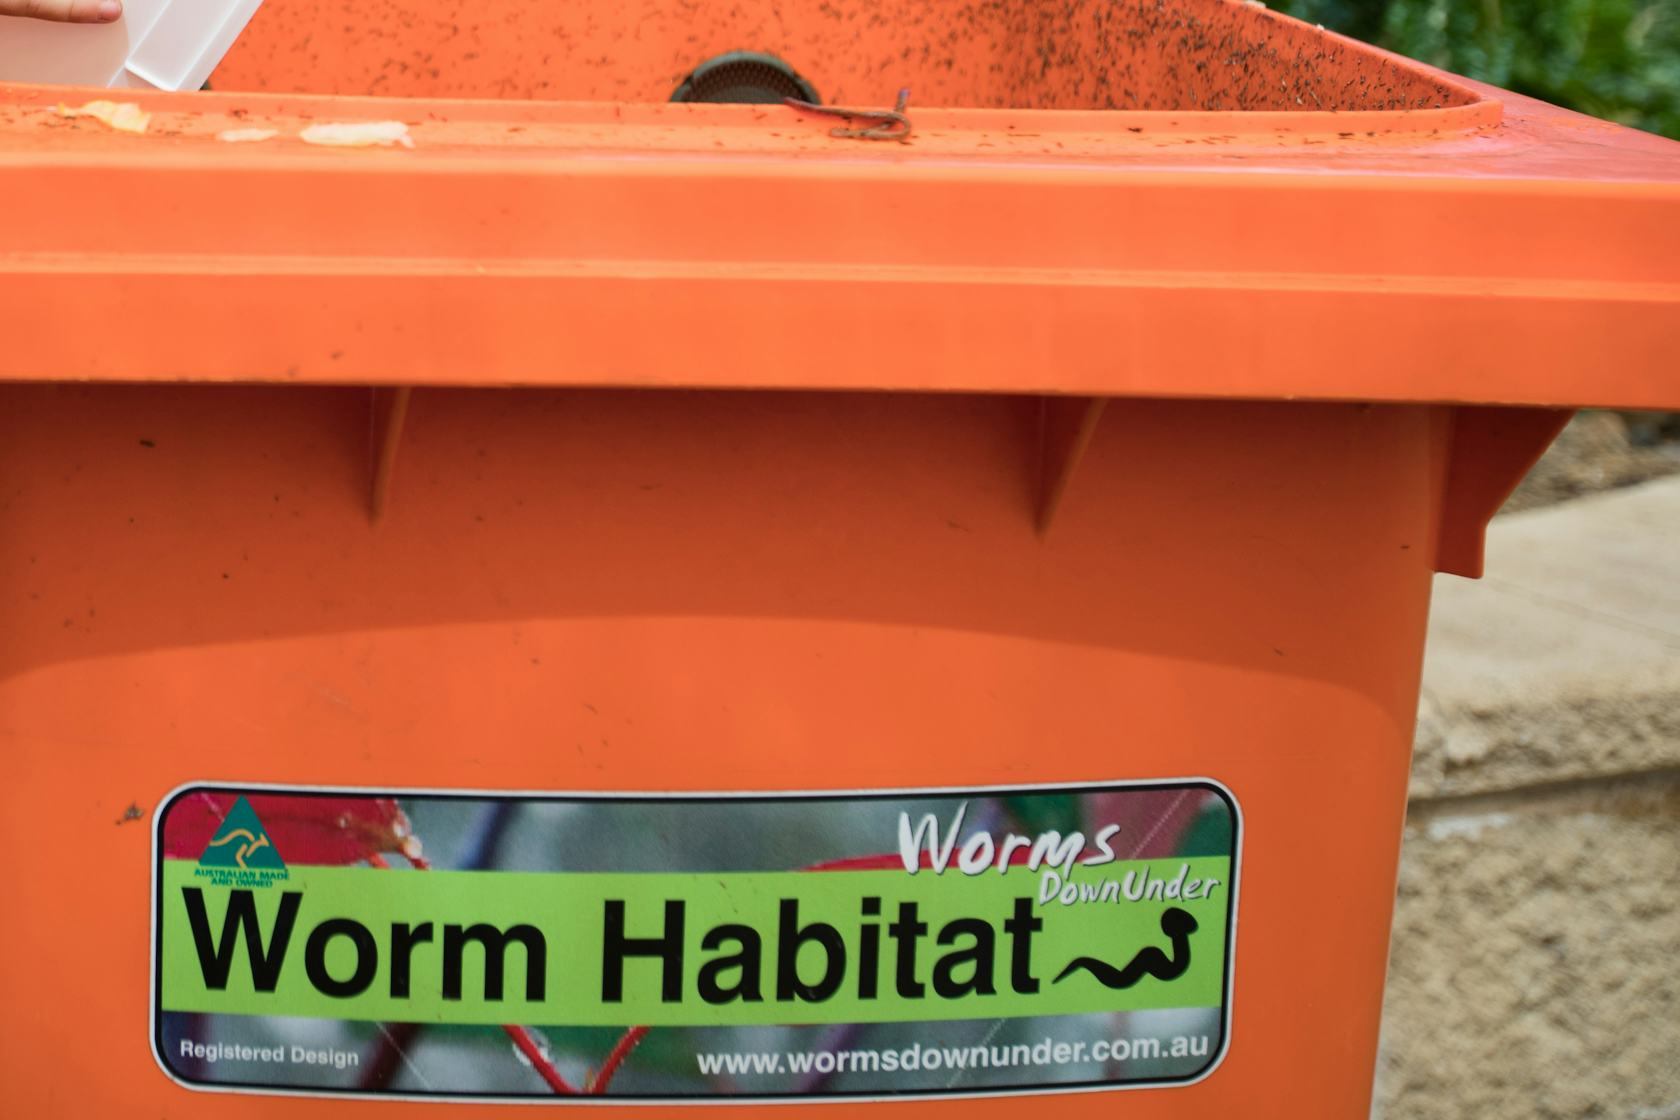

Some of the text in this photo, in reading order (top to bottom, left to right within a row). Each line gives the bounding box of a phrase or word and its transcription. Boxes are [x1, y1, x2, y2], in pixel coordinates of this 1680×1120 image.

[898, 800, 1121, 878] Worms
[194, 868, 289, 881] AUSTRALIAN MADE
[211, 878, 273, 888] AND OWNED
[1038, 864, 1222, 906] DownUnder
[181, 886, 1043, 1005] Worm Habitat
[179, 1039, 360, 1068] Registered Design
[697, 1034, 1209, 1077] www.wormsdownunder.com.au
